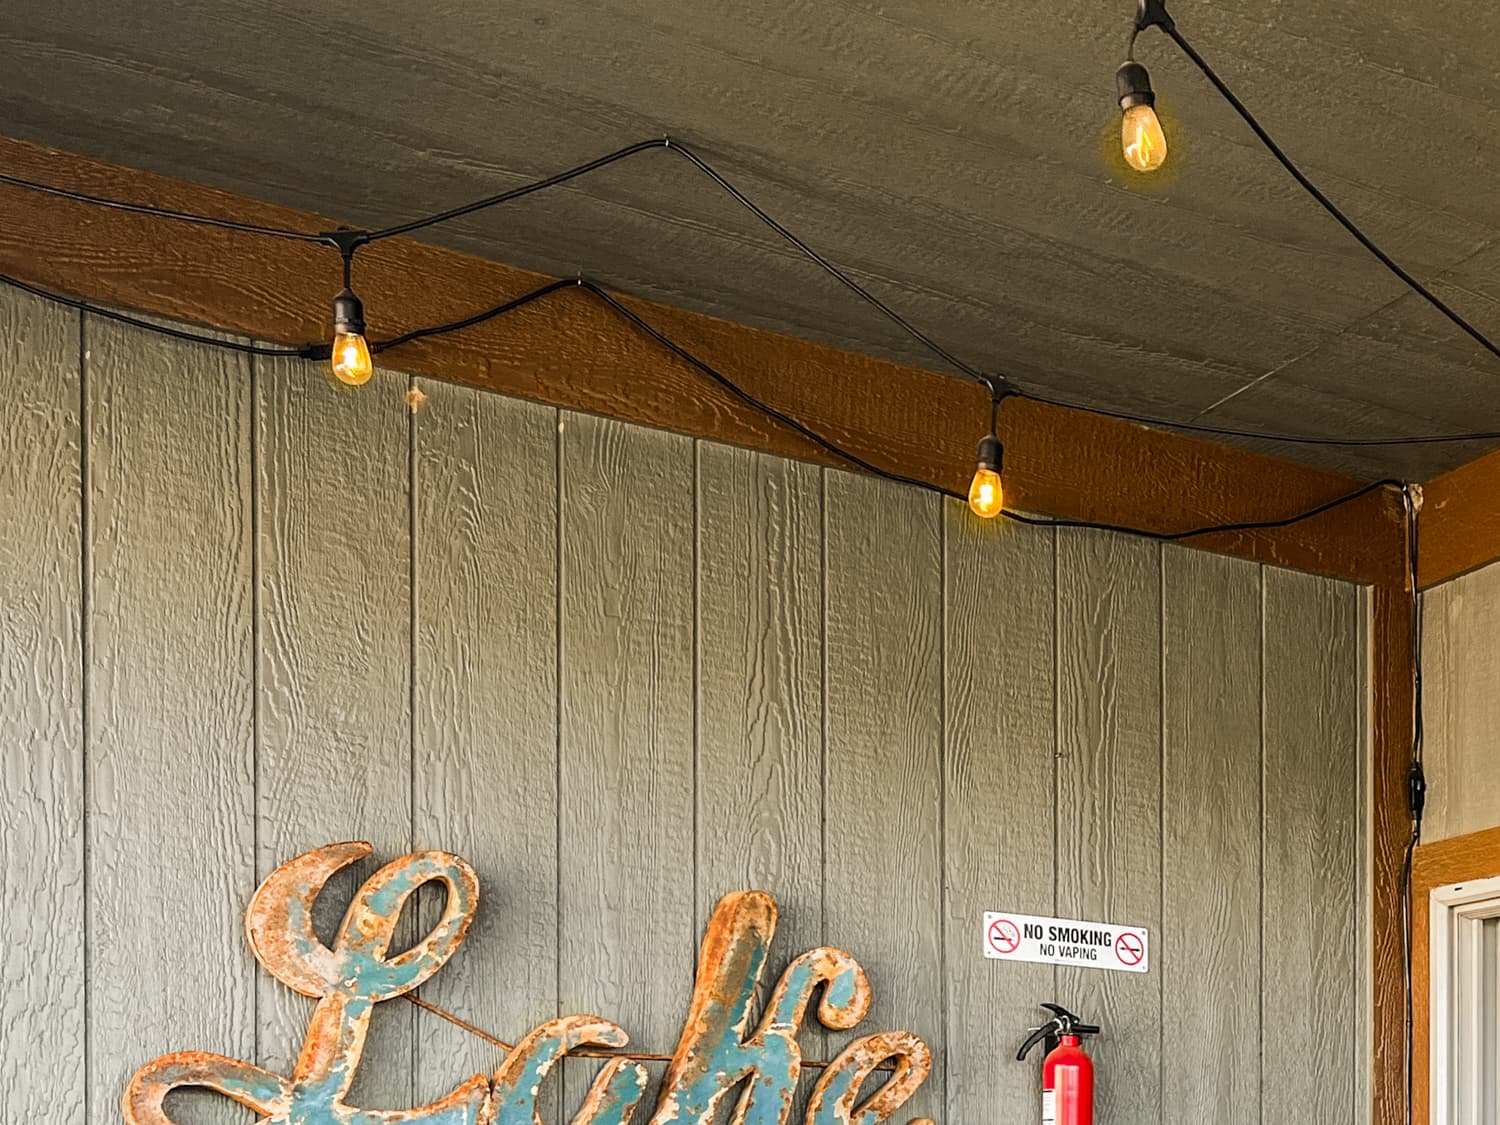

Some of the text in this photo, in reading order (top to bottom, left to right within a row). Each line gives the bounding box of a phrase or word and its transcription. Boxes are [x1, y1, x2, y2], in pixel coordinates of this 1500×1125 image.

[1023, 923, 1112, 947] NO SMOKING
[1039, 943, 1097, 961] NO VAPING
